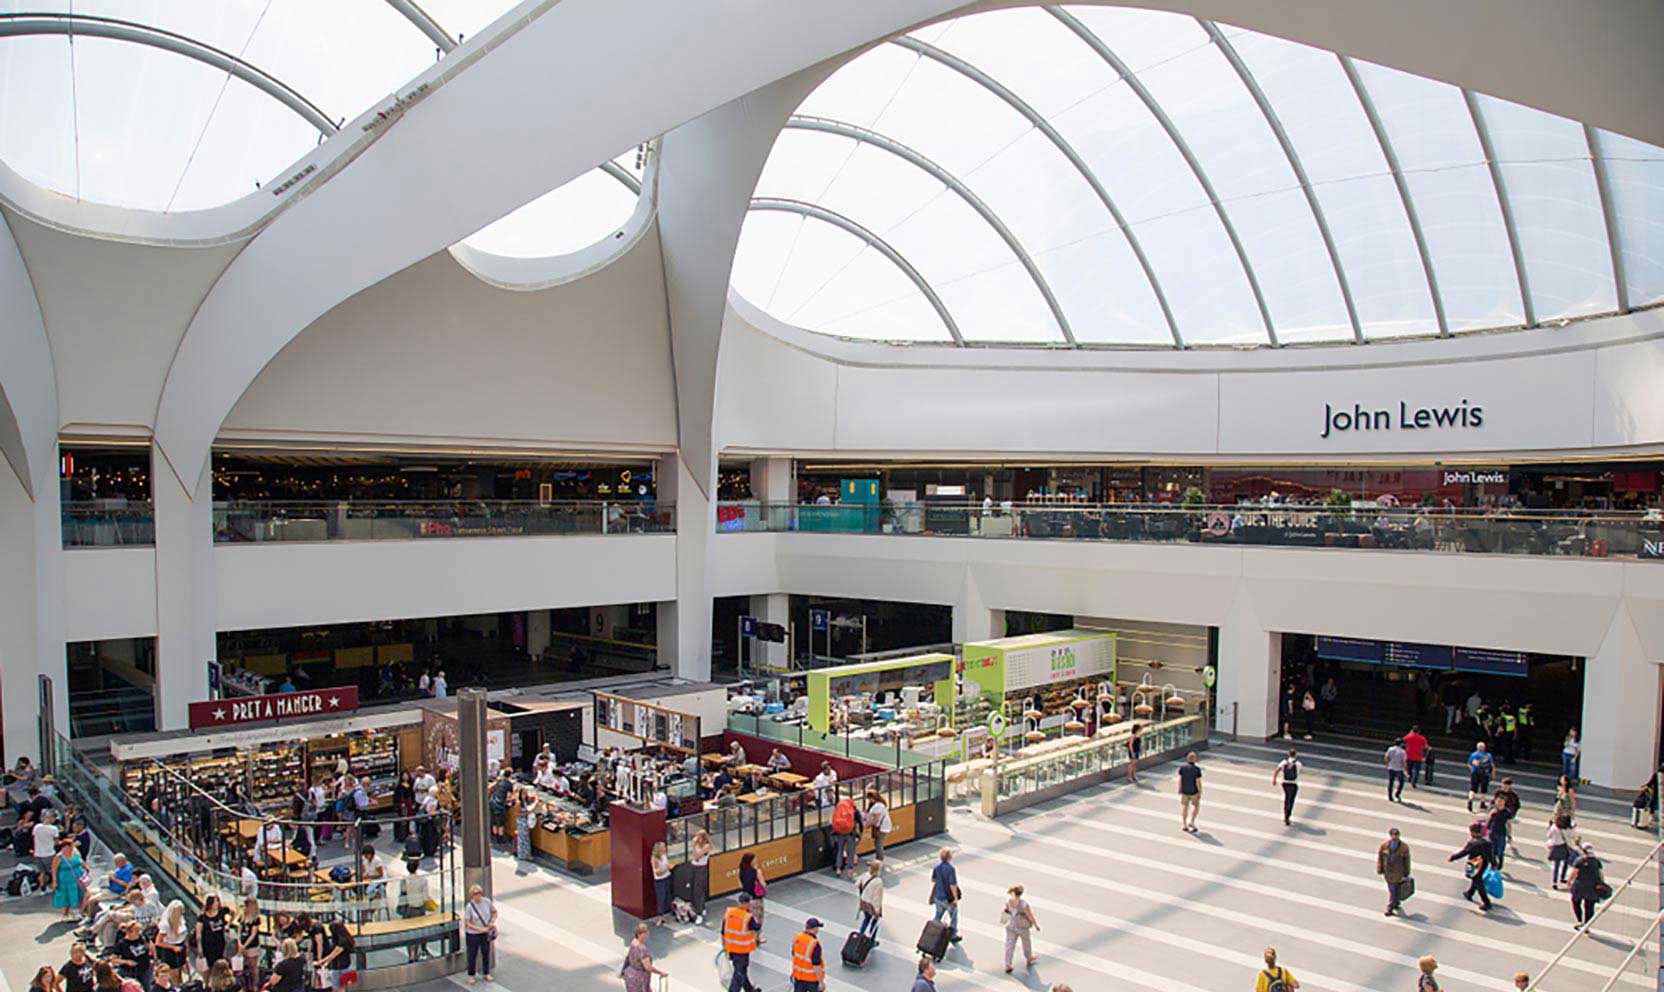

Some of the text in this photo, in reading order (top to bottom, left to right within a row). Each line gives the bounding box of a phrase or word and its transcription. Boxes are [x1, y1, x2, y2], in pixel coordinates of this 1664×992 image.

[1321, 399, 1483, 438] John Lewis
[1443, 472, 1504, 486] John Lewis
[596, 613, 604, 632] 9
[232, 694, 322, 720] PRET A MANGER
